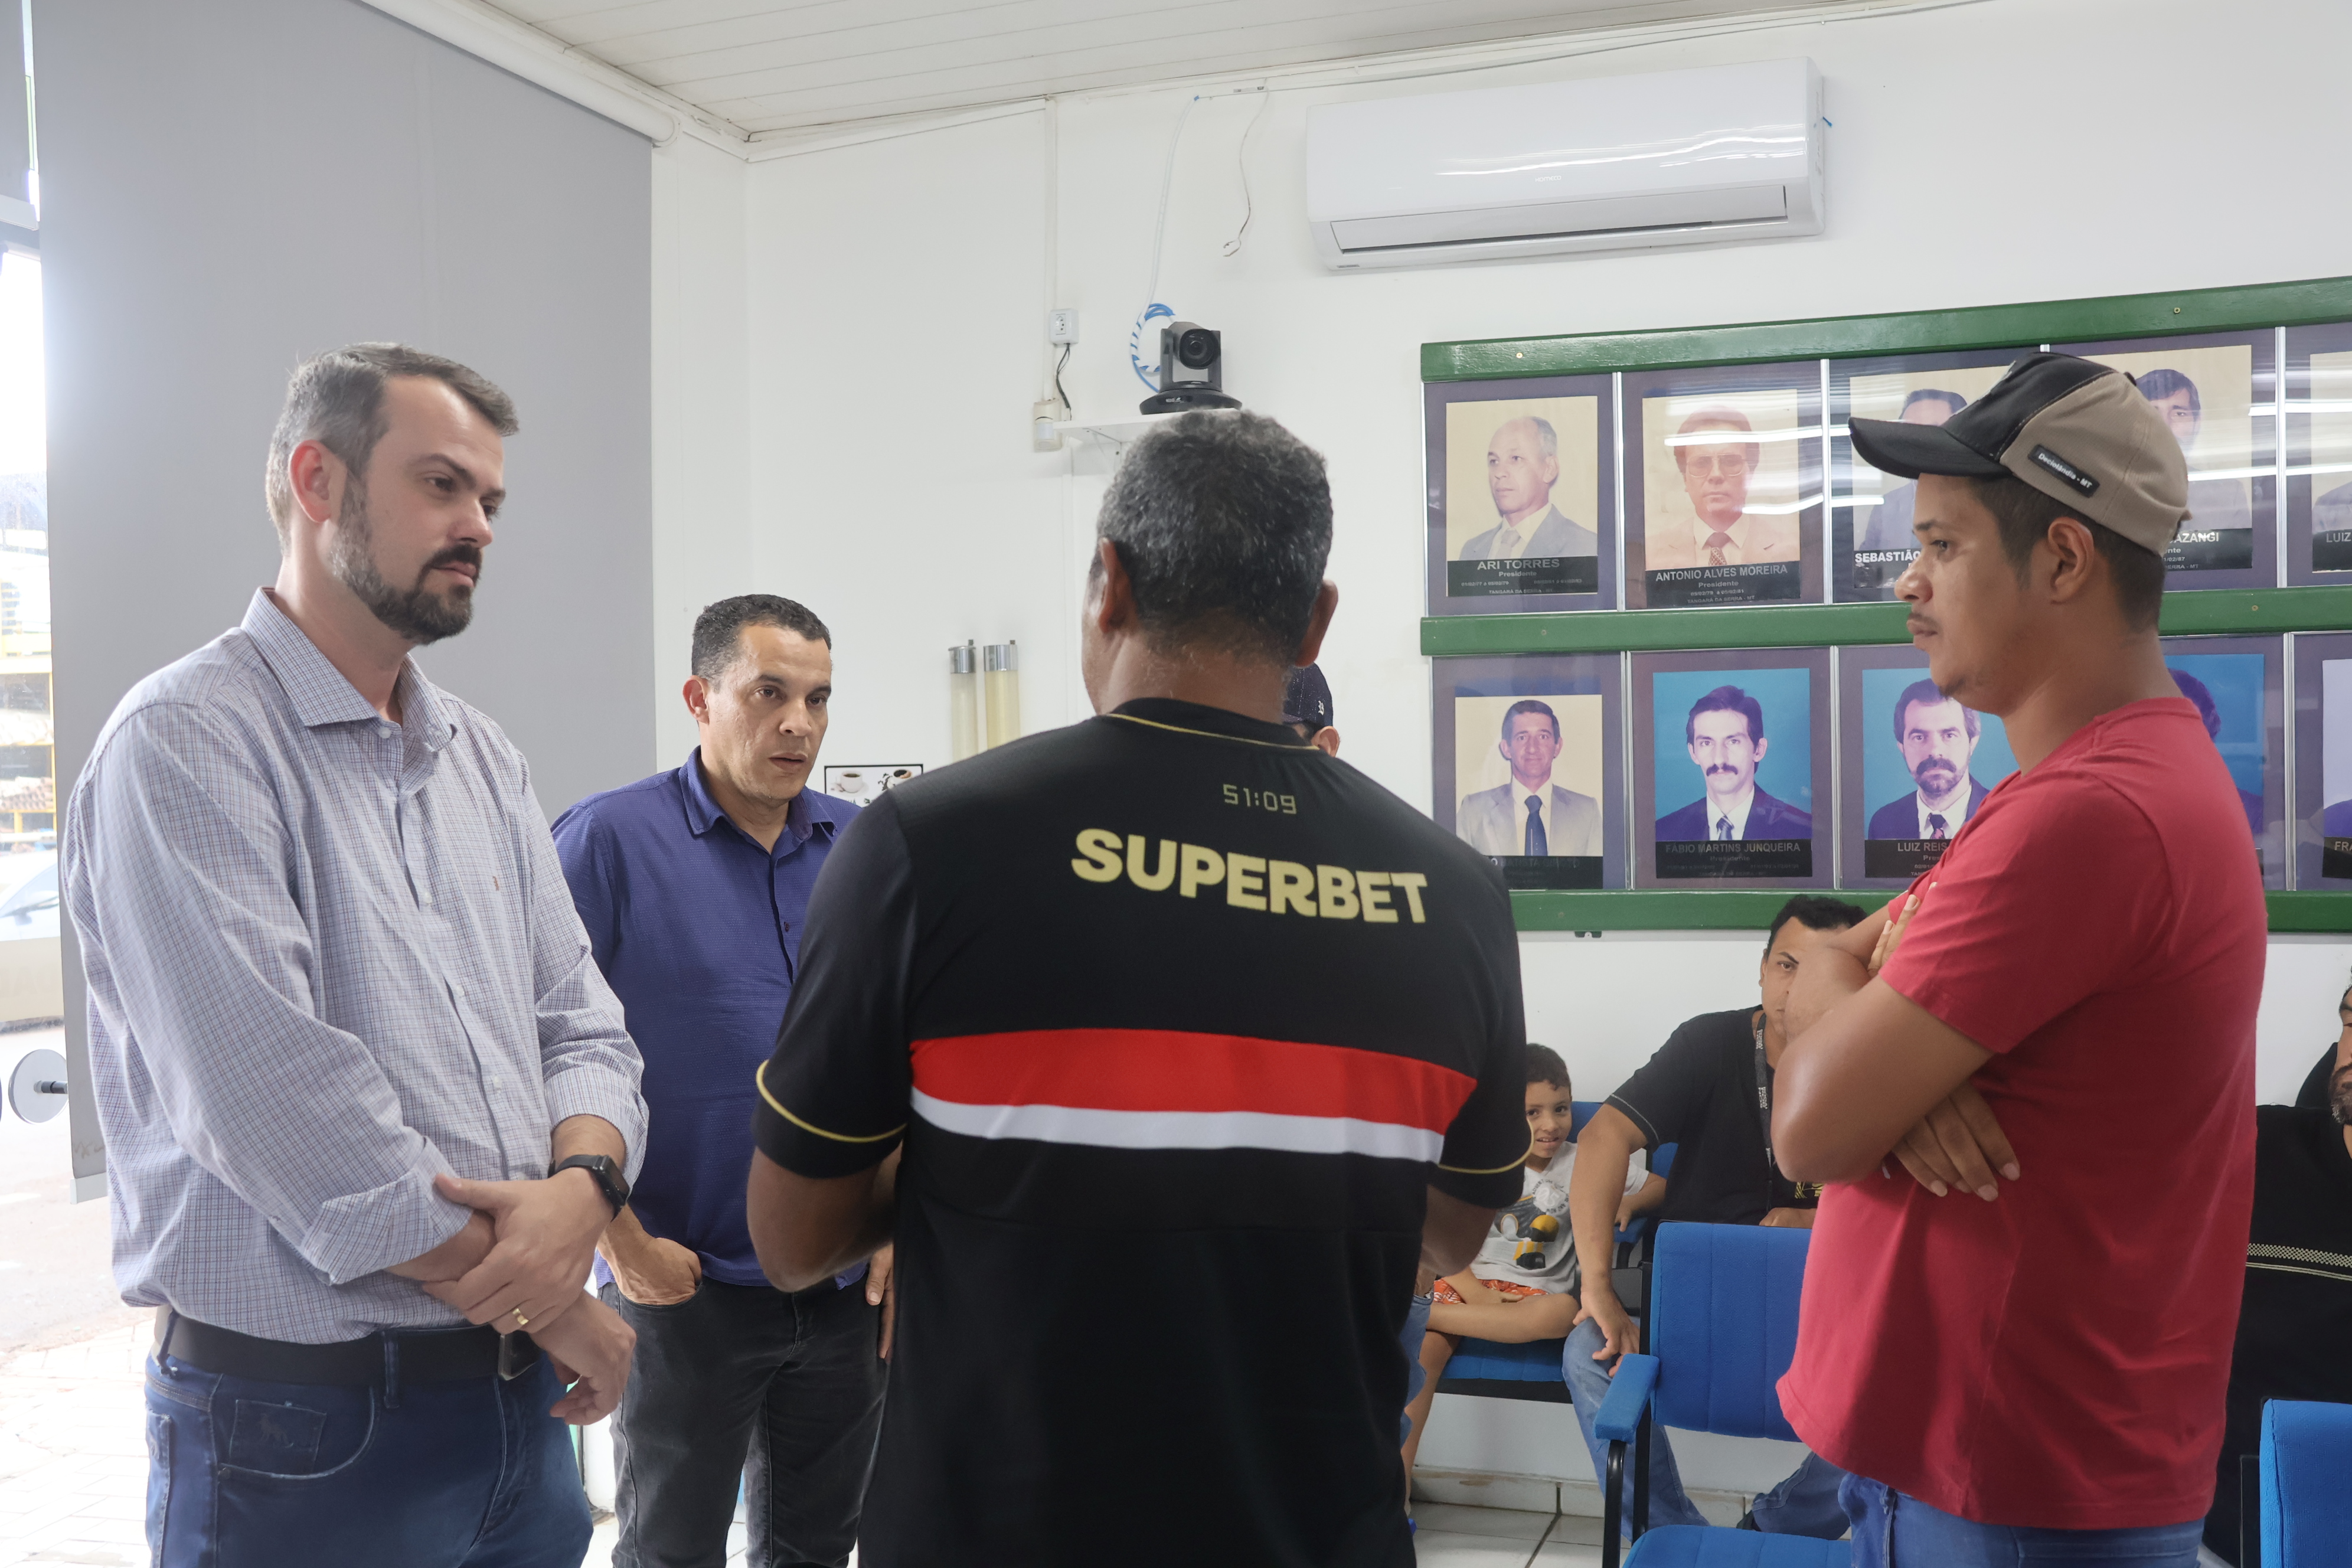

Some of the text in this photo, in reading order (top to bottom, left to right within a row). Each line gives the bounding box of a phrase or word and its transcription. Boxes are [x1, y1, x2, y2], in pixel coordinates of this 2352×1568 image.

[2038, 453, 2076, 480] Deciolândia
[2080, 478, 2093, 488] MT
[2170, 532, 2219, 543] AZANGI
[2326, 533, 2352, 543] LUIZ
[1855, 550, 1921, 563] SEBASTIÃO
[1477, 558, 1560, 570] ARI TORRES
[1655, 564, 1788, 582] ANTONIO ALVES MOREIRA
[1222, 783, 1298, 815] 51:09
[1698, 842, 1741, 853] MARTINS
[1744, 842, 1801, 853] JUNQUEIRA
[1897, 842, 1921, 852] LUIZ
[1070, 827, 1428, 925] SUPERBET
